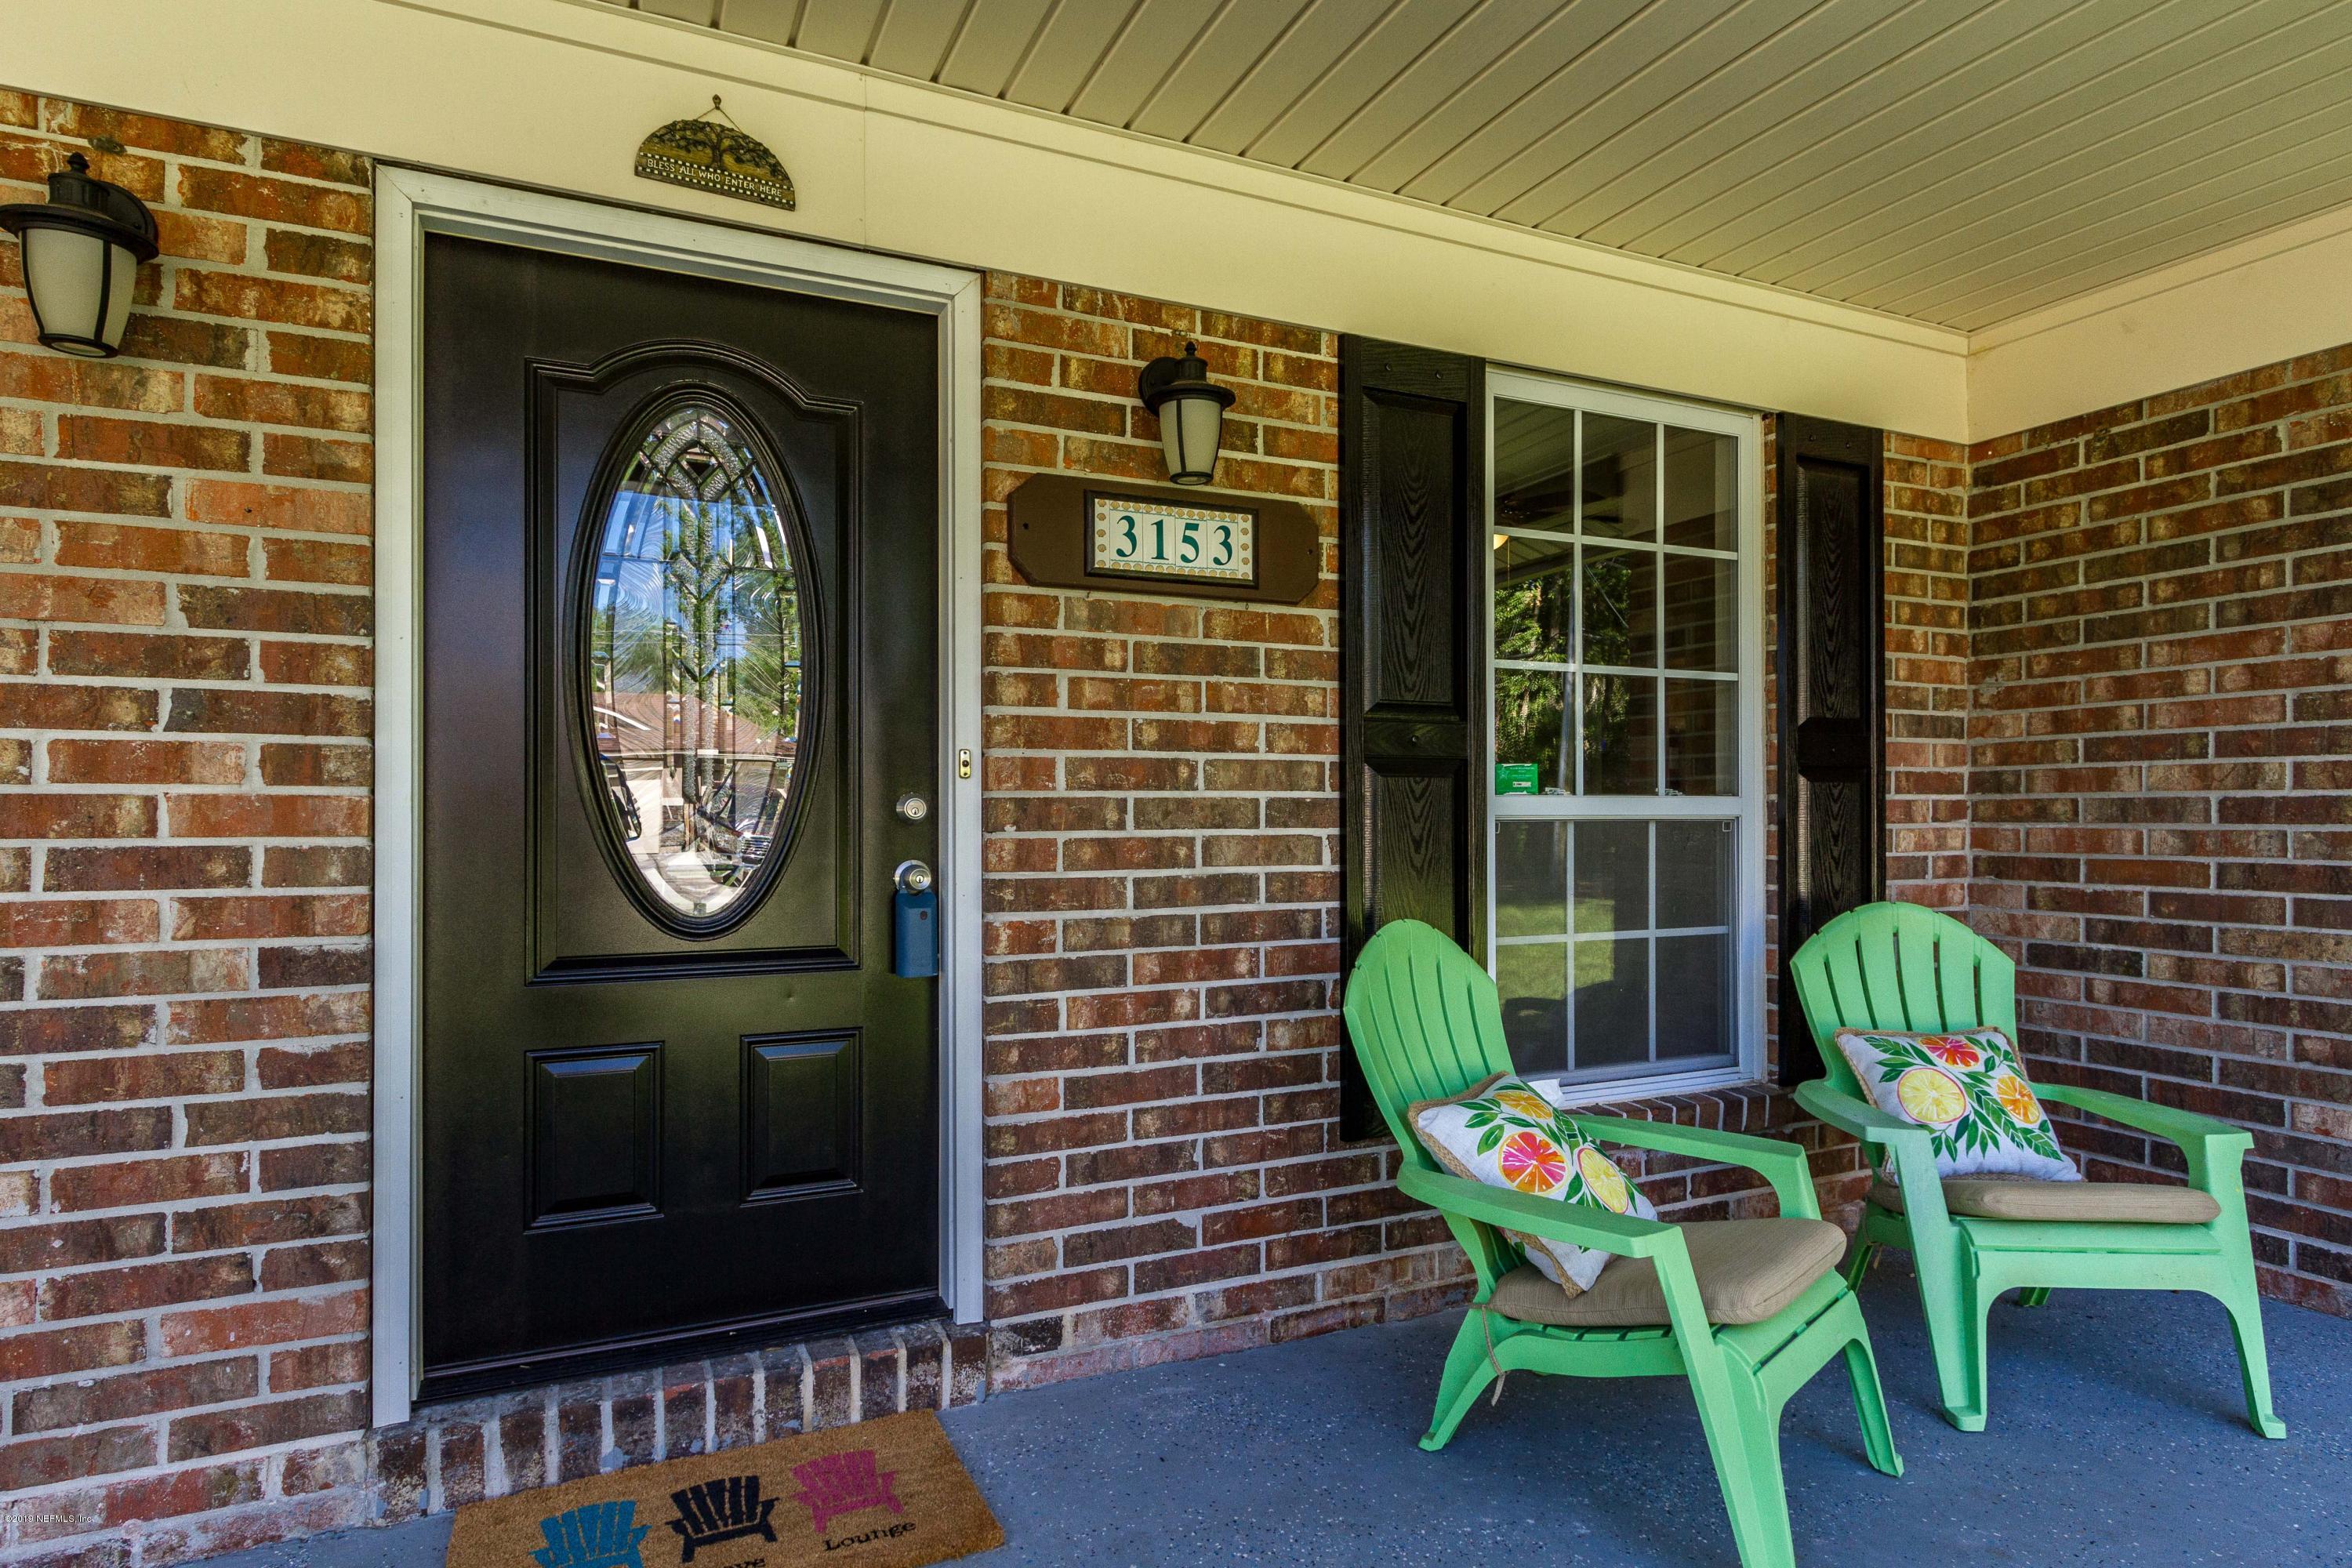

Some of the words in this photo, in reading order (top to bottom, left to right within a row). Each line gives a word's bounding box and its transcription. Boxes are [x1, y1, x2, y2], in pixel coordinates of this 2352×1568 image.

[647, 159, 675, 172] BLESS
[679, 167, 696, 176] ALL
[699, 170, 720, 181] WHO
[725, 176, 755, 190] ENTER
[760, 185, 782, 197] HERE
[1116, 515, 1233, 566] 3153
[824, 1521, 917, 1552] Lounge
